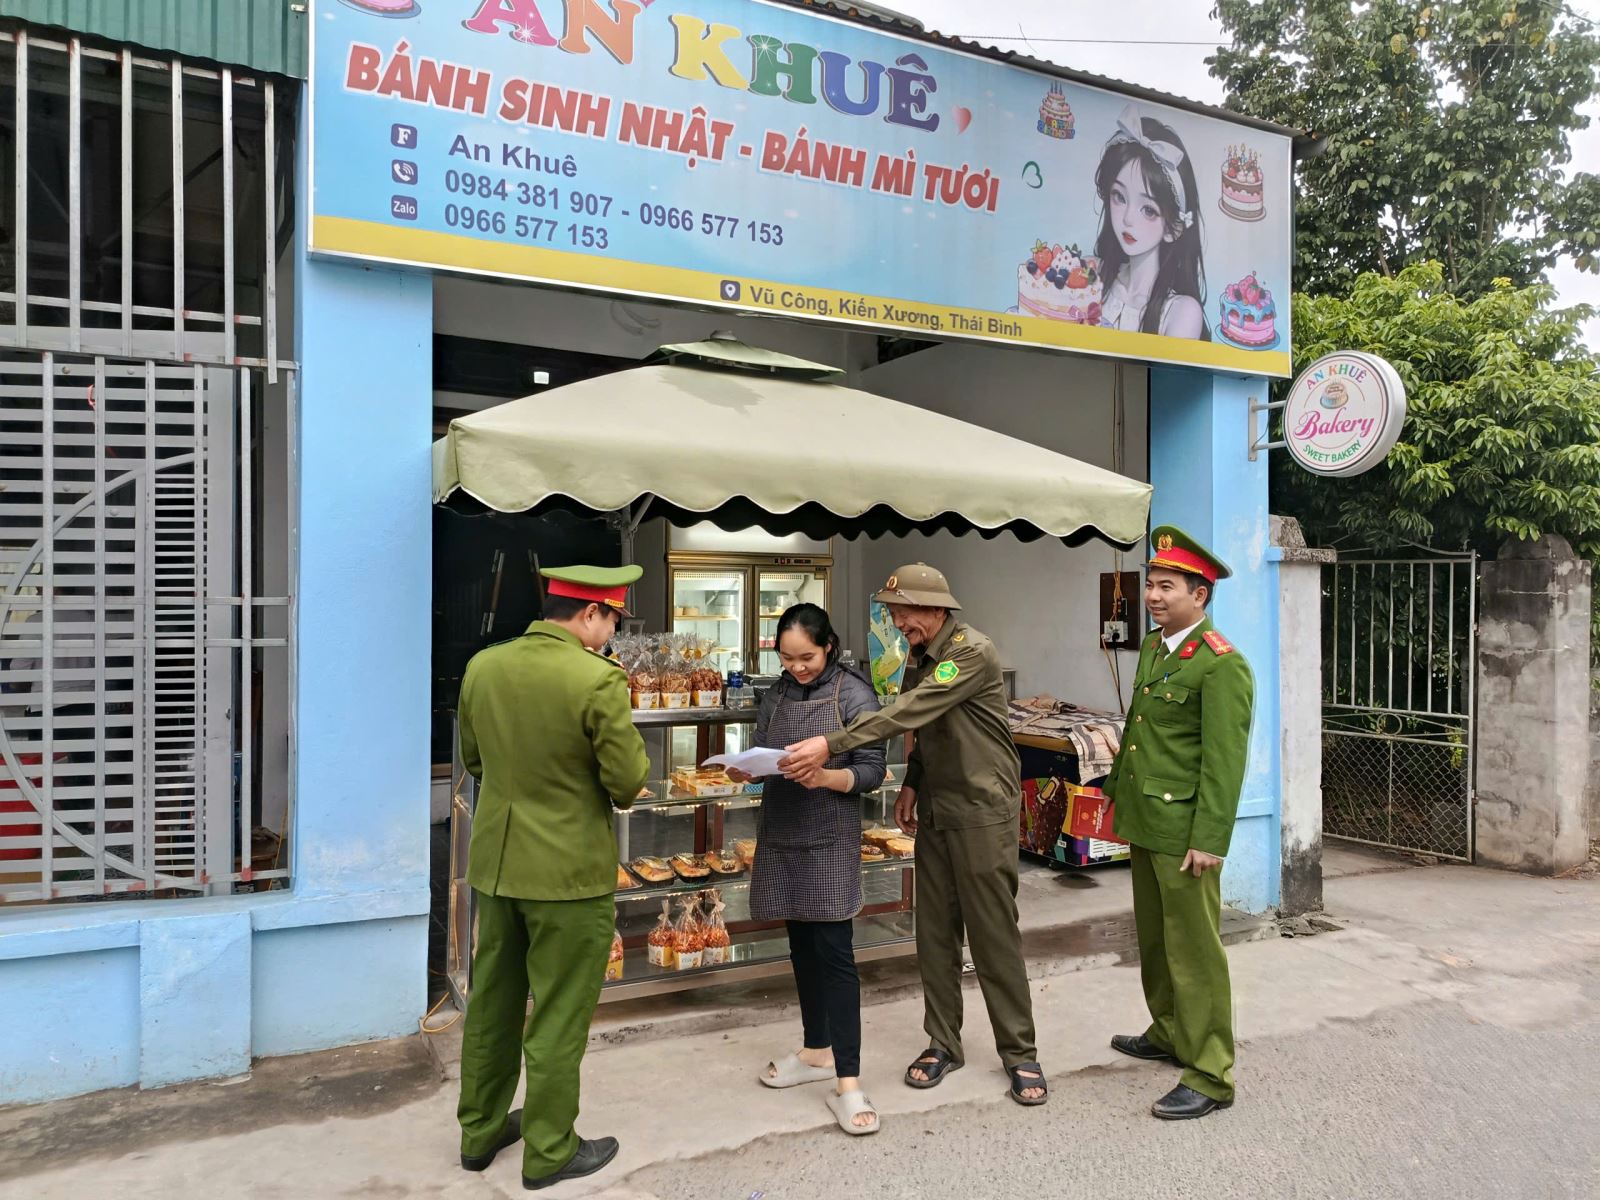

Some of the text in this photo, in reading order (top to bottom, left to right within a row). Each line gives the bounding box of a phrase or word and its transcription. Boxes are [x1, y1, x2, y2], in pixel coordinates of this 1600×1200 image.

[669, 14, 940, 132] KHUÊ
[346, 41, 491, 114] BÁNH
[499, 78, 611, 137] SINH
[619, 101, 734, 168] NHẬT
[761, 126, 867, 187] BÁNH
[871, 150, 917, 197] MÌ
[923, 164, 999, 212] TƯƠI
[449, 134, 577, 177] An Khuê
[393, 201, 416, 215] Zalo
[444, 203, 609, 250] 0966 577 153
[445, 169, 508, 201] 0984
[516, 181, 560, 210] 381
[570, 191, 613, 218] 907
[639, 202, 694, 232] 0966
[701, 212, 739, 239] 577
[747, 220, 784, 246] 153
[750, 285, 1022, 338] Vũ Công, Kiến Xương, Thái Bình
[1306, 369, 1325, 390] AN
[1328, 363, 1367, 384] KHUÊ
[1293, 406, 1375, 440] Bakery
[1303, 439, 1362, 463] SWEET BAKERY
